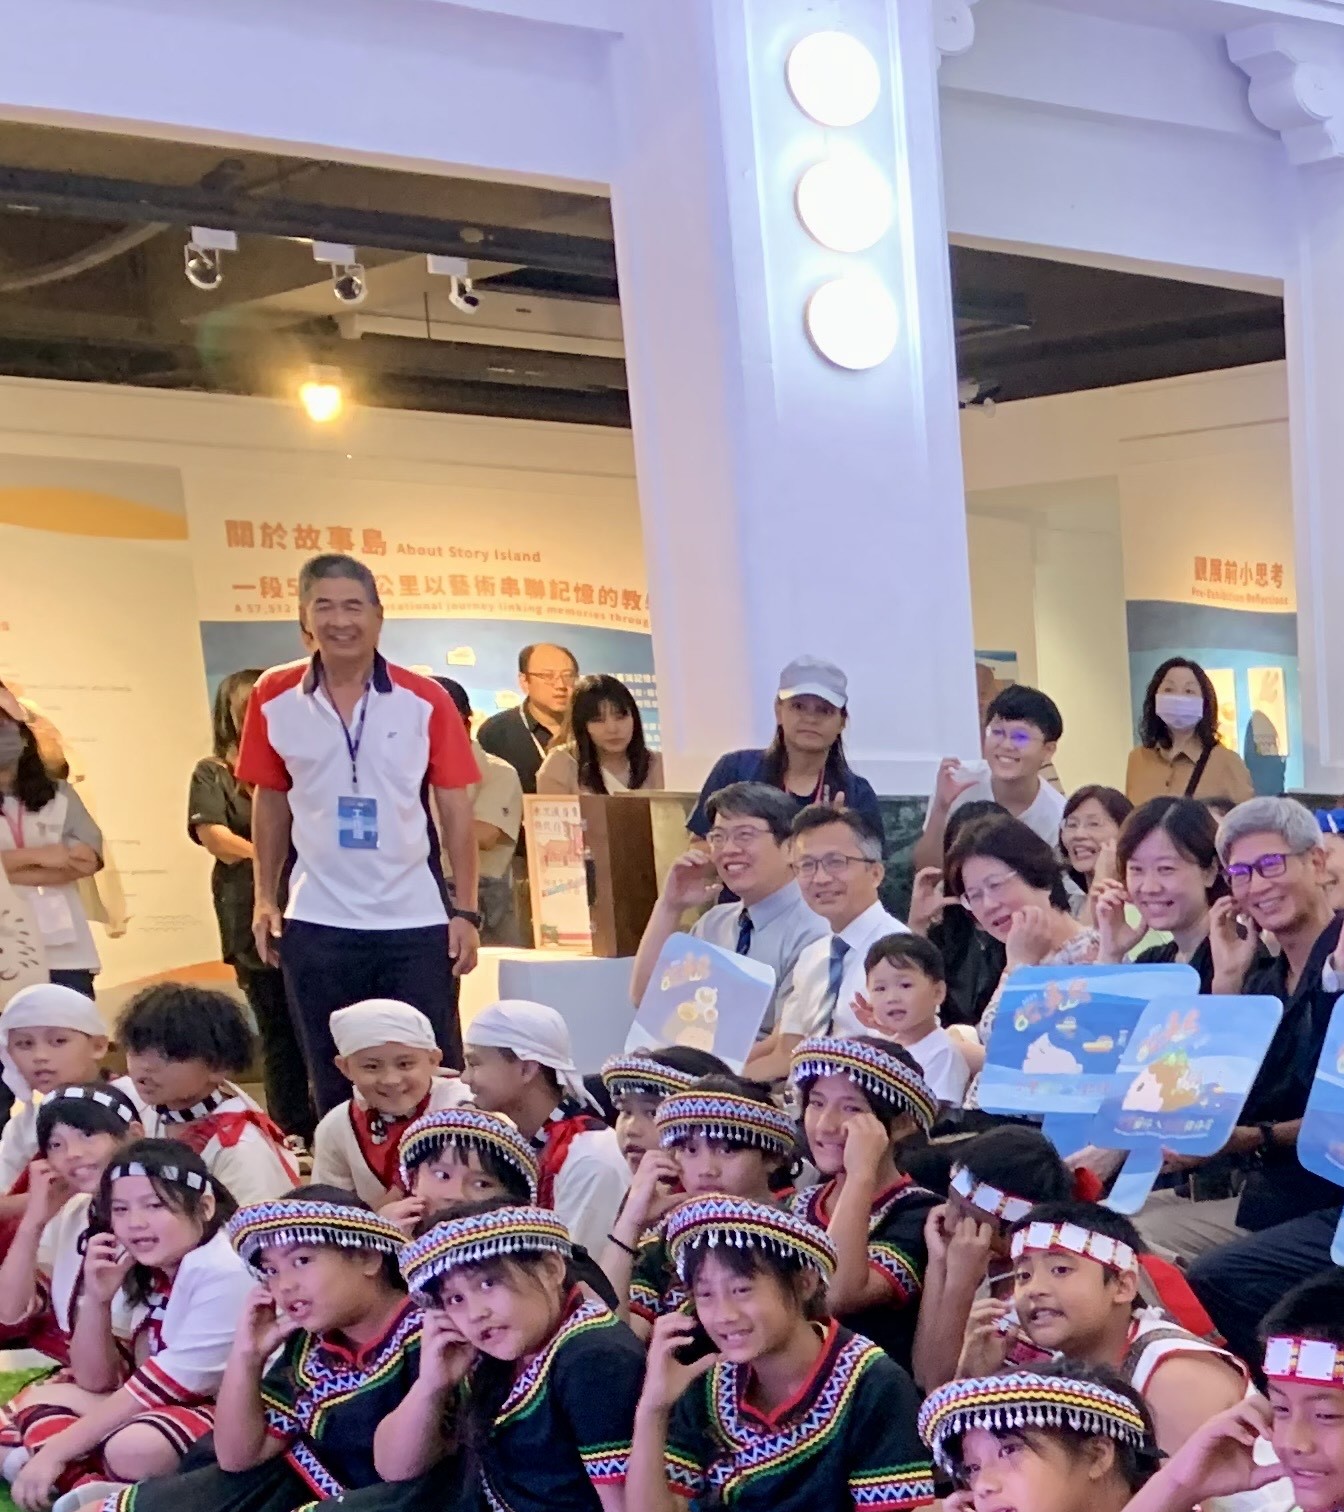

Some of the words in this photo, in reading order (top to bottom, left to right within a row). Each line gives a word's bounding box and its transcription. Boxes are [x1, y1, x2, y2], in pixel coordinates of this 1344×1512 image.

[225, 519, 388, 557] 關於故事島
[397, 543, 444, 558] About
[449, 546, 490, 563] Story
[494, 549, 542, 563] Island
[1194, 556, 1284, 589] 觀展前小思考
[611, 612, 650, 628] throug
